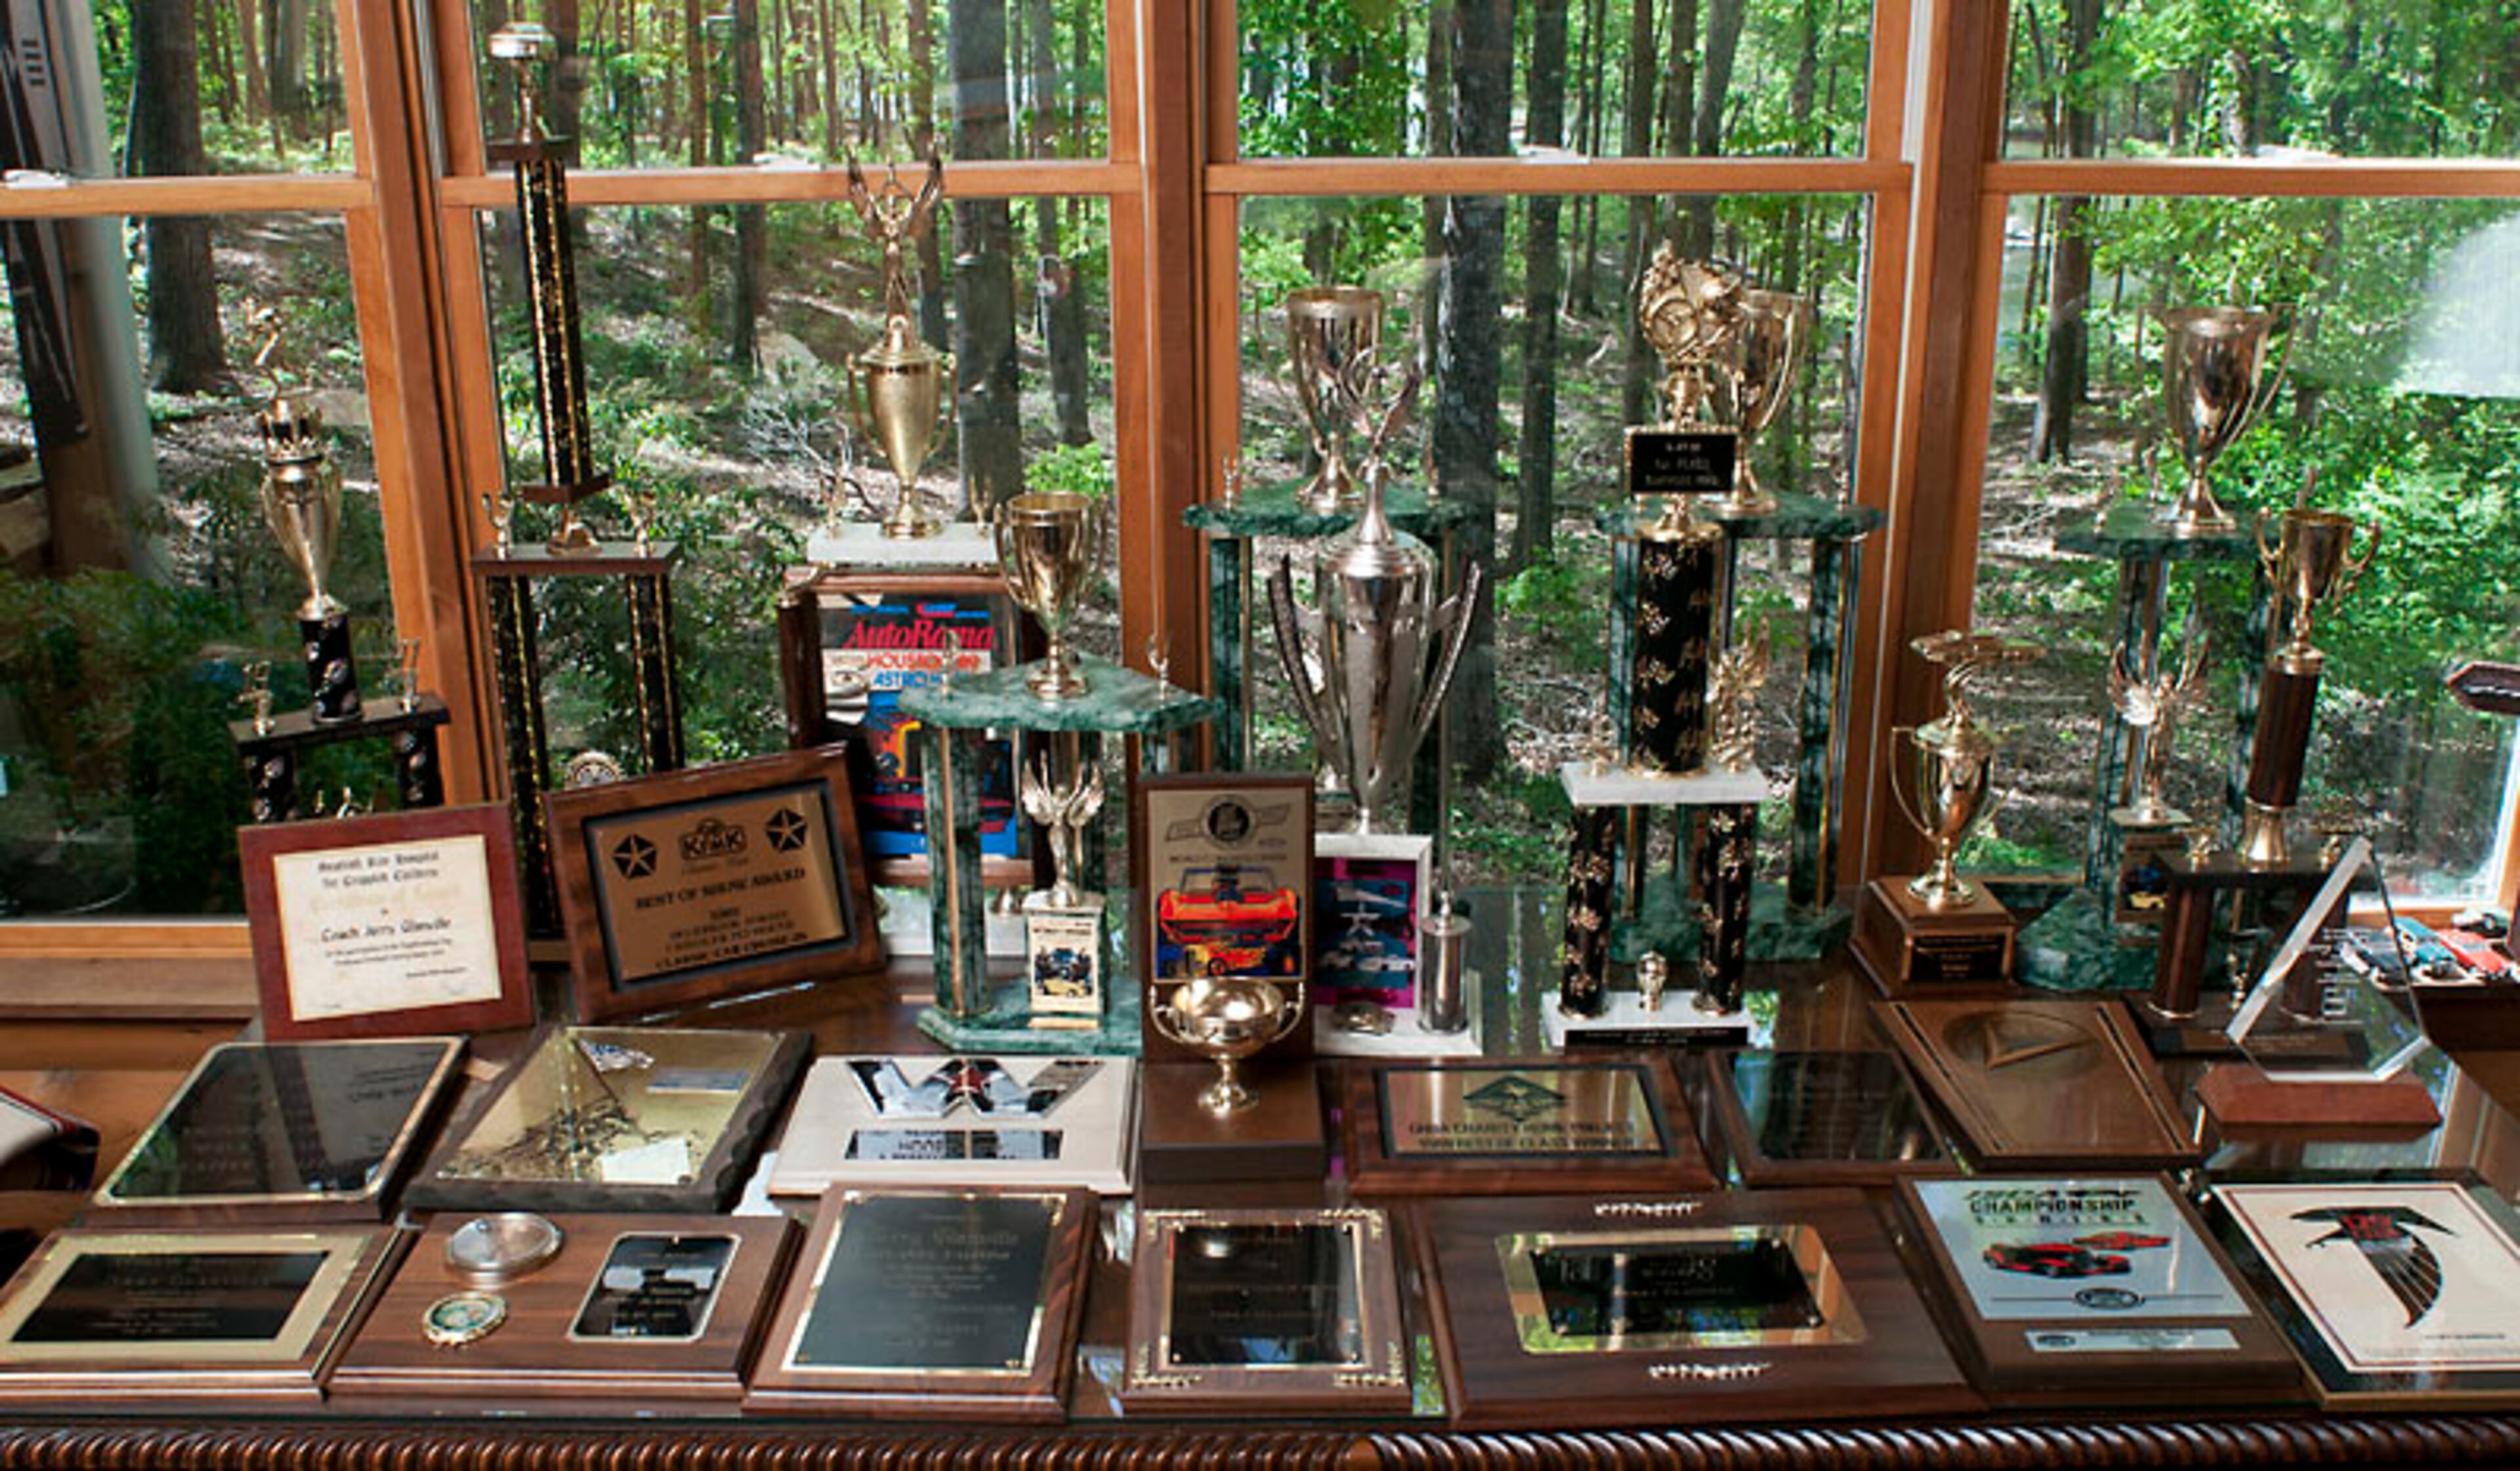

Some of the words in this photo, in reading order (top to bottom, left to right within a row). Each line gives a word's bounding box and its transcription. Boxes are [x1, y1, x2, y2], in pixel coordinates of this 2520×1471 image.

[867, 652, 954, 669] HOUSTO
[637, 892, 674, 908] BEST
[678, 887, 697, 903] OF
[321, 926, 360, 943] Coach
[400, 919, 451, 933] Glanville
[1969, 1198, 2133, 1213] CHAMPIONSHIP
